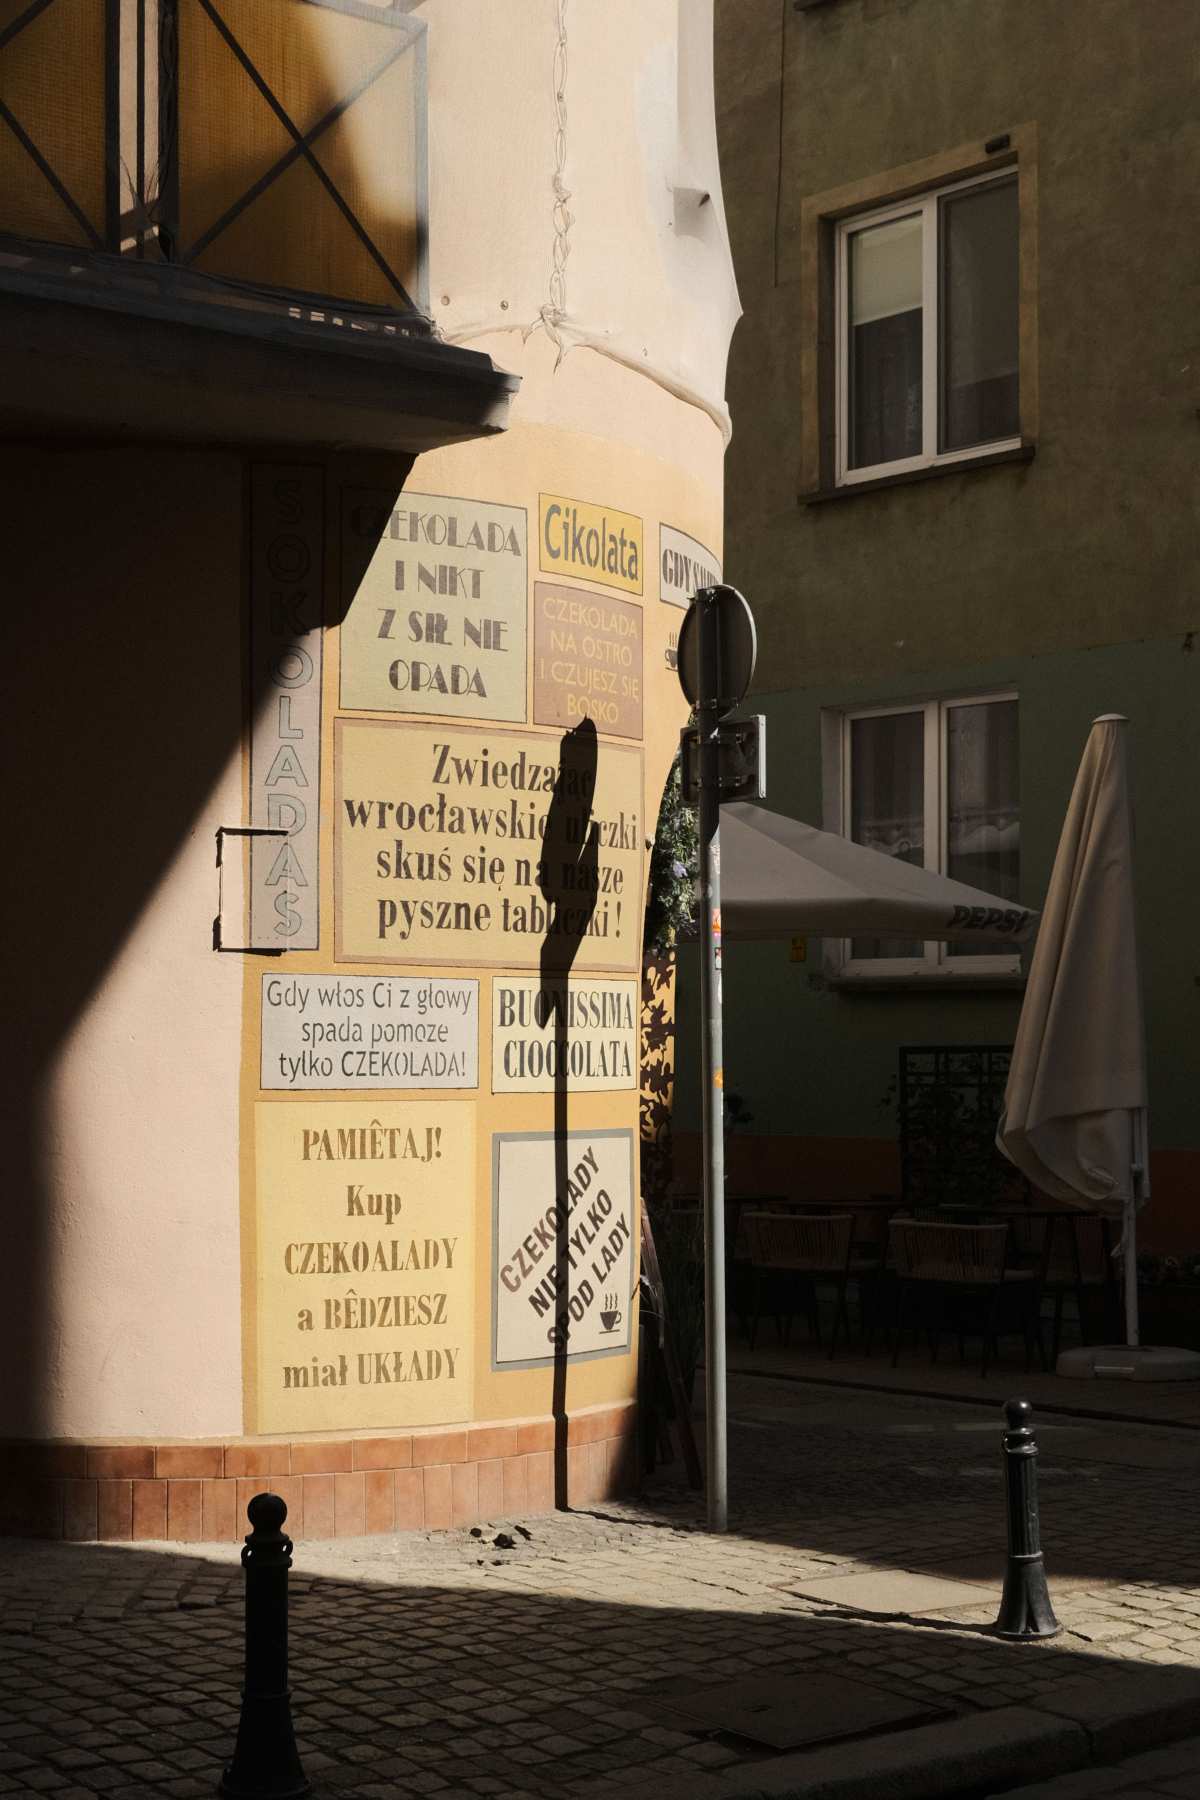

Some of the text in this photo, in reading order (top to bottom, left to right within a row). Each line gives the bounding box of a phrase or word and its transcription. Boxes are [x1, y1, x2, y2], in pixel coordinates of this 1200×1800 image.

[544, 504, 638, 581] Cikolata
[395, 560, 484, 600] I NIKT
[662, 549, 691, 593] GDY
[377, 608, 508, 652] Z SIŁ NIE
[543, 598, 638, 640] CZEKOLADA
[550, 630, 632, 667] NA OSTRO
[388, 659, 487, 698] OPADA
[551, 661, 618, 694] CZUJESZ
[567, 694, 619, 724] BOSKO
[344, 793, 552, 841] wrocławskie
[376, 840, 452, 882] skuś
[463, 846, 505, 891] się
[515, 858, 549, 887] na
[378, 899, 491, 940] pyszne
[267, 980, 472, 1015] Gdy włos Ci z głowy
[498, 988, 634, 1029] BUONISSIMA
[301, 1016, 449, 1048] spada pomoze
[279, 1051, 466, 1083] tylko CZEKOLADA!
[504, 1040, 632, 1078] CIOCCOLATA
[346, 1184, 402, 1224] Kup
[500, 1146, 599, 1293] CZEKOLADY
[284, 1237, 458, 1275] CZEKOALADY
[528, 1189, 612, 1318] NIE TYLKO
[591, 1212, 630, 1283] LADY
[297, 1308, 313, 1331] a
[282, 1348, 460, 1389] miał UKŁADY
